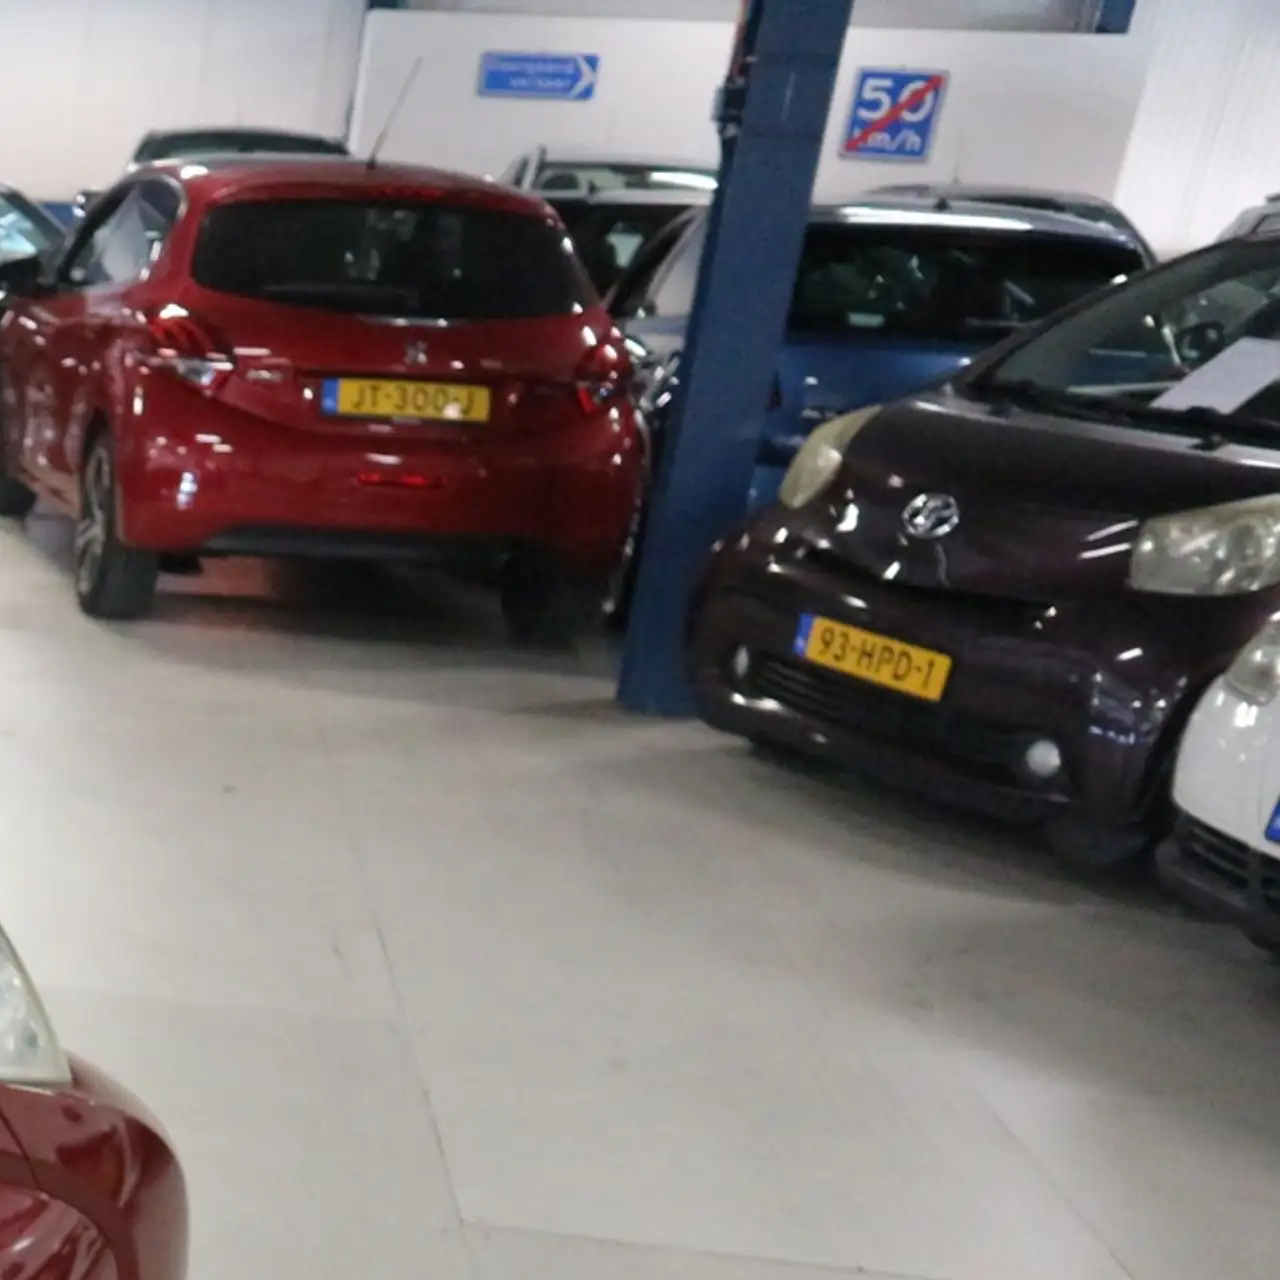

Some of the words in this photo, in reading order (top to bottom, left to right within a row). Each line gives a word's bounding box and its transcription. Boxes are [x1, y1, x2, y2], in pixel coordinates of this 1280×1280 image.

[856, 78, 934, 122] 50
[350, 383, 475, 416] JT-300-J
[817, 626, 936, 691] 93-HPD-1
